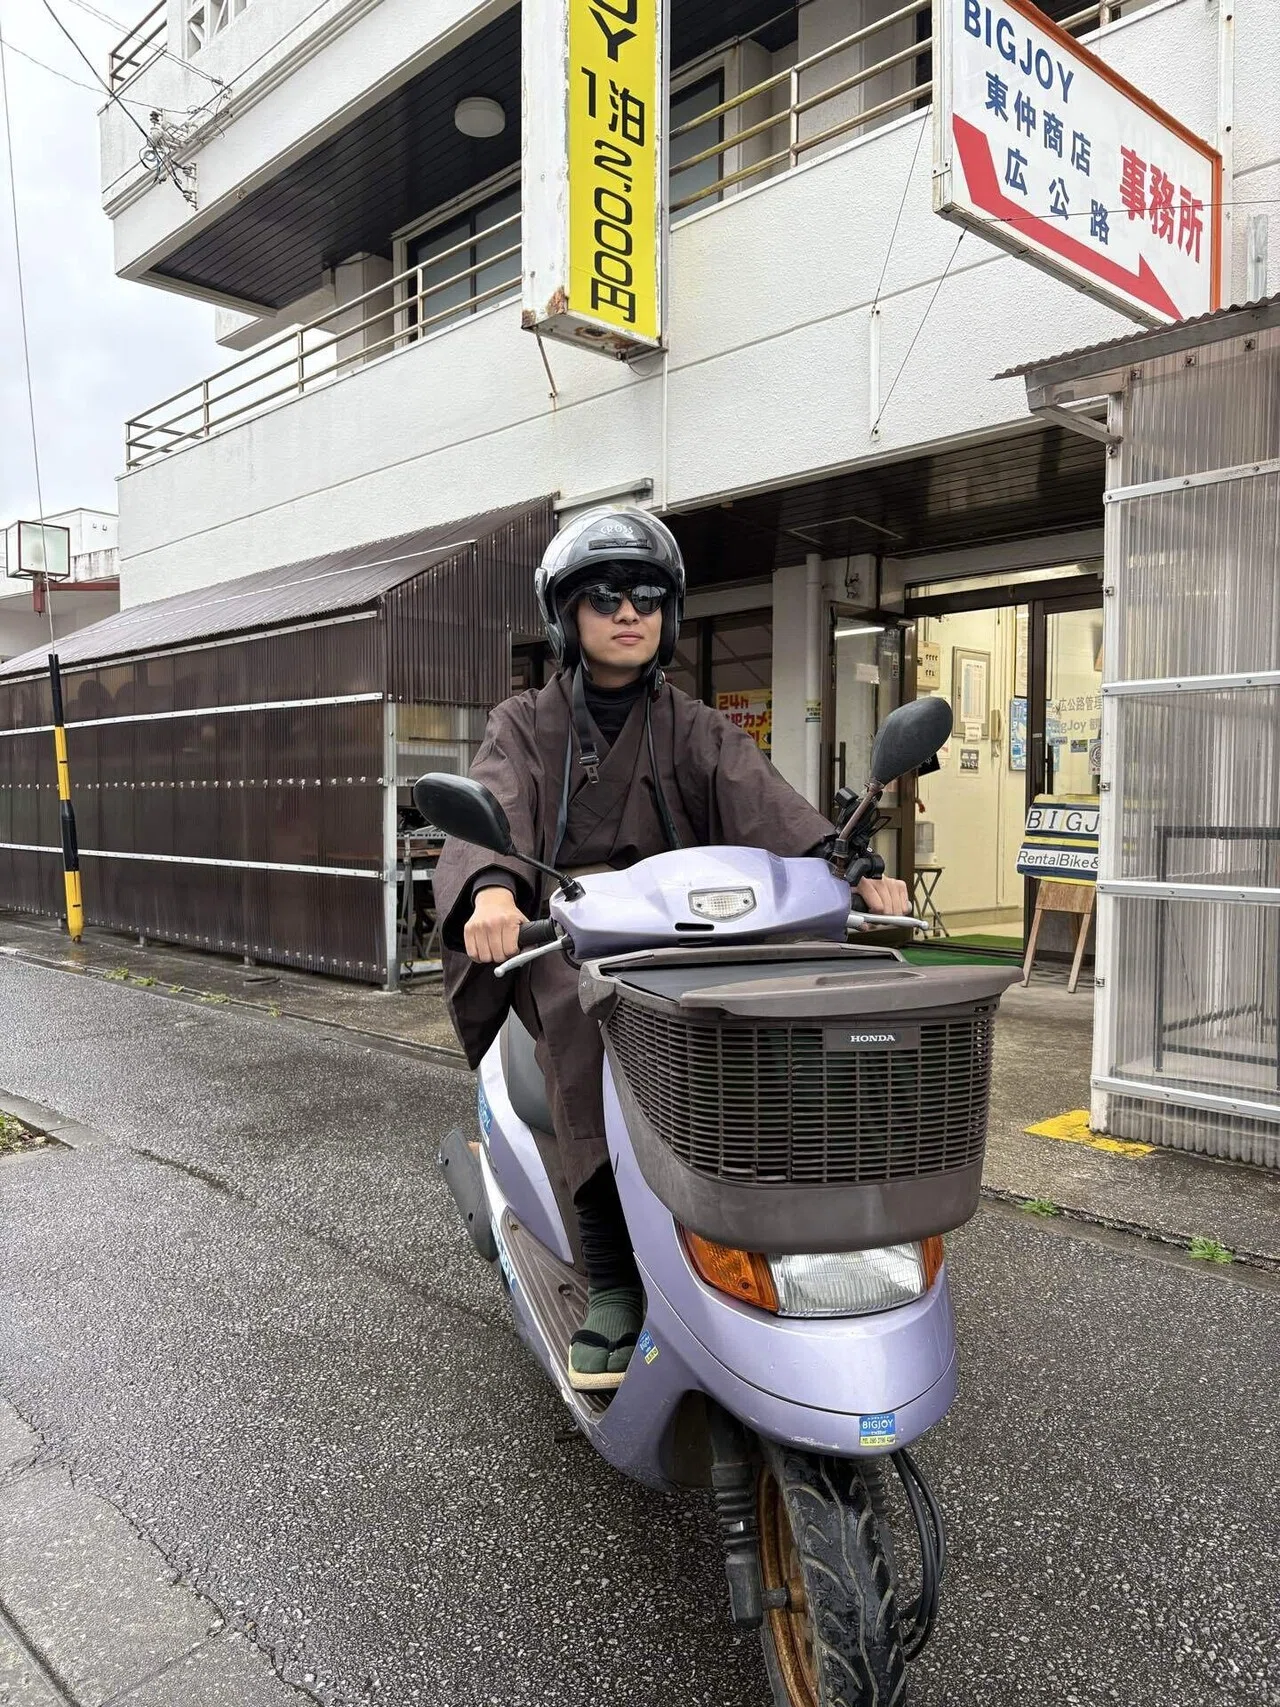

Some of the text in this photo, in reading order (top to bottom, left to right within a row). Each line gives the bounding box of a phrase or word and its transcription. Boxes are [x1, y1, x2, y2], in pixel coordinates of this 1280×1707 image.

[964, 0, 1075, 104] BIGJOY
[985, 71, 1091, 177] 東仲商店
[1120, 145, 1204, 263] 事務所
[850, 1034, 896, 1042] HONDA
[862, 1419, 894, 1430] BIGJOY
